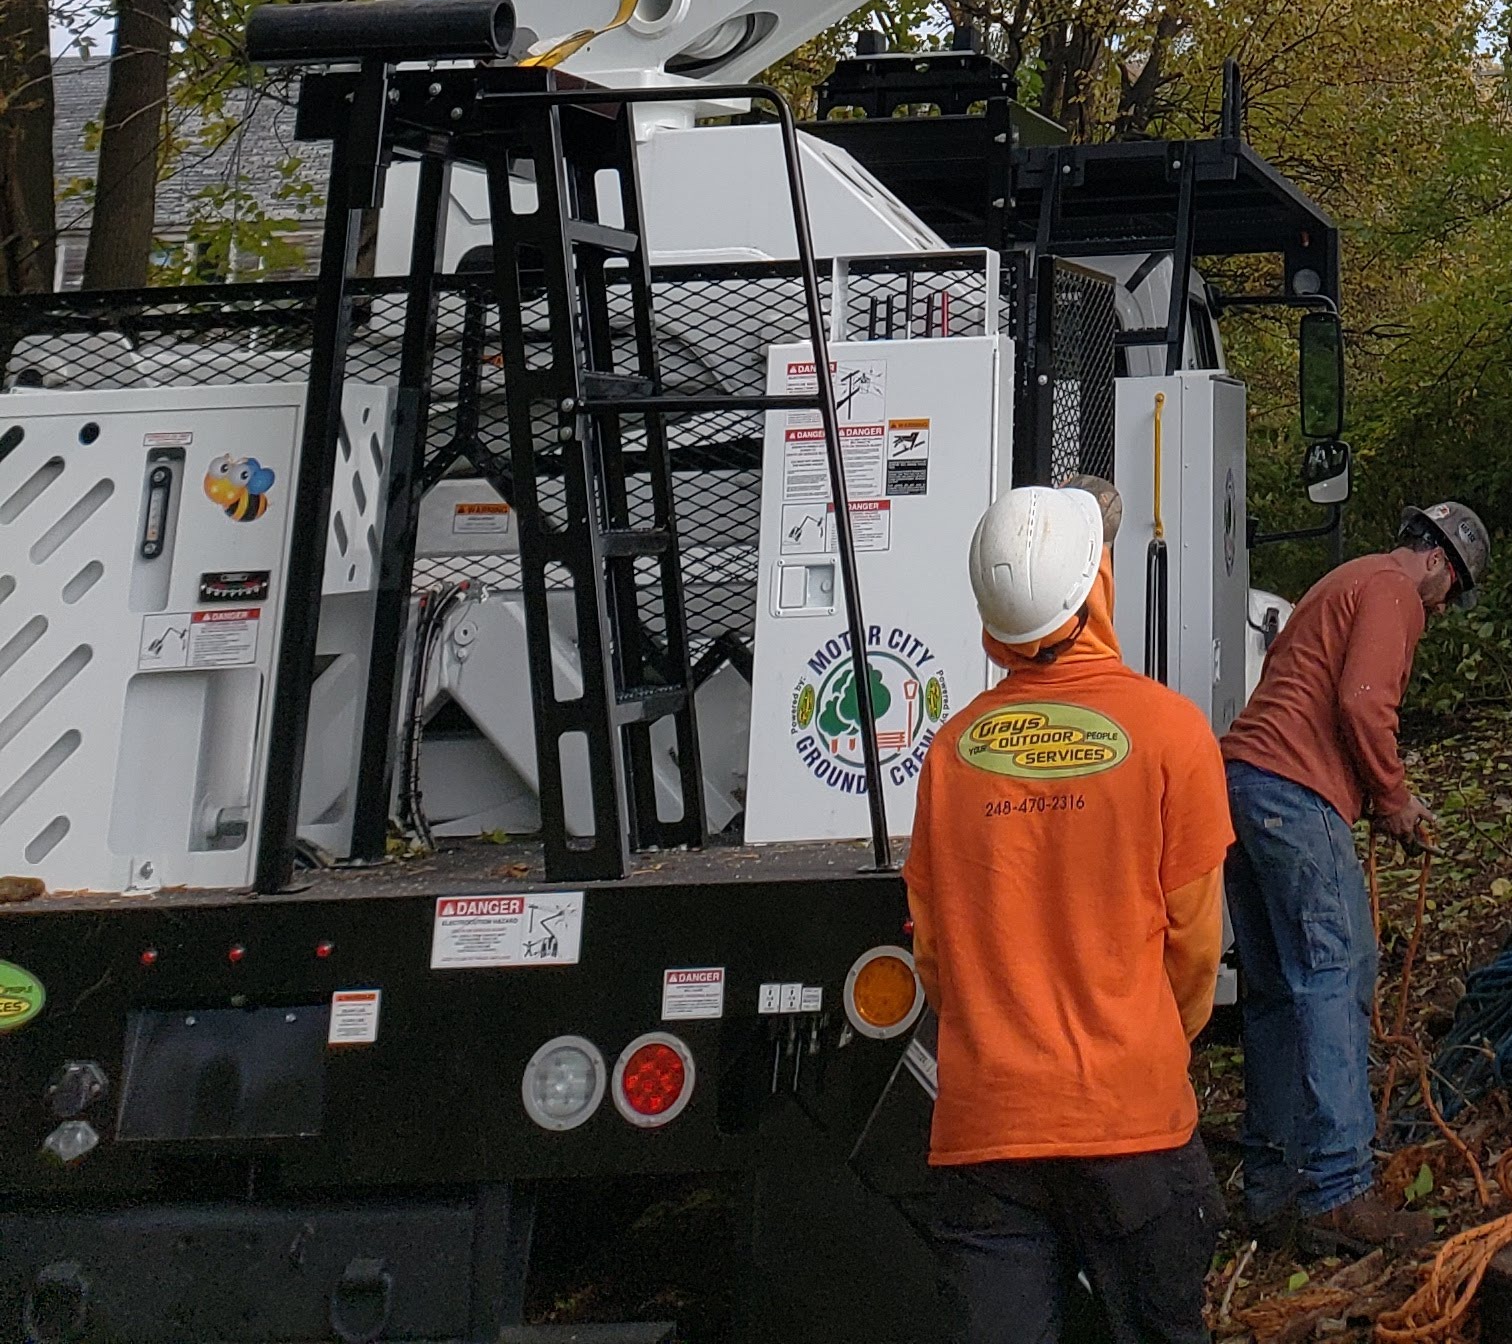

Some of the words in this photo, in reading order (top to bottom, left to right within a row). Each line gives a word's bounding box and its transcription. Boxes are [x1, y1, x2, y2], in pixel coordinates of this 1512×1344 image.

[797, 364, 835, 373] DANR
[797, 430, 825, 439] DANGE
[846, 427, 882, 436] DANGER
[212, 612, 248, 621] DANGER
[807, 625, 881, 676] MOTR
[887, 628, 935, 668] CITY
[977, 716, 1042, 739] Grays
[998, 731, 1073, 749] OUTDOOR
[1086, 731, 1118, 741] PEOPLE
[1025, 748, 1105, 765] SERVICES
[796, 735, 868, 795] GROUND
[984, 794, 1085, 817] 248-470-2316
[456, 900, 520, 915] DANGER
[678, 972, 720, 982] DANGER
